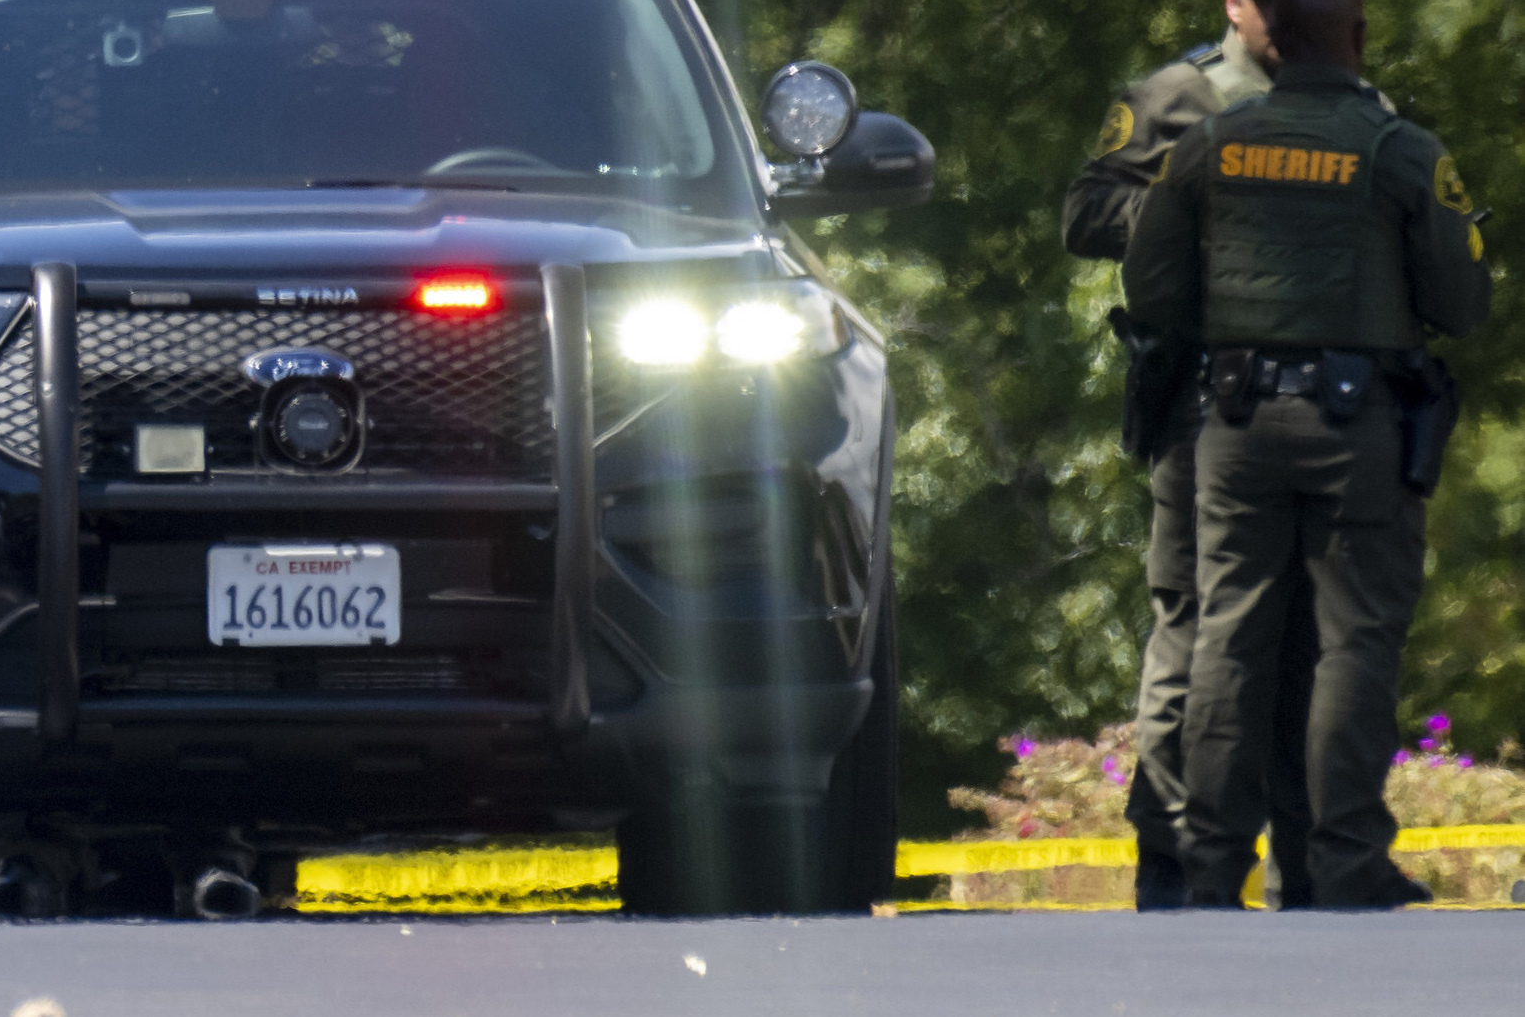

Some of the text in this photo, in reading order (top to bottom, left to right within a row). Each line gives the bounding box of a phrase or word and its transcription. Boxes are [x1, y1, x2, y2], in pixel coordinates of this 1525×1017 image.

[1219, 142, 1360, 185] SHERIFF
[257, 286, 359, 305] SETINA
[255, 560, 352, 576] CA EXEMPT
[223, 584, 387, 630] 1616062
